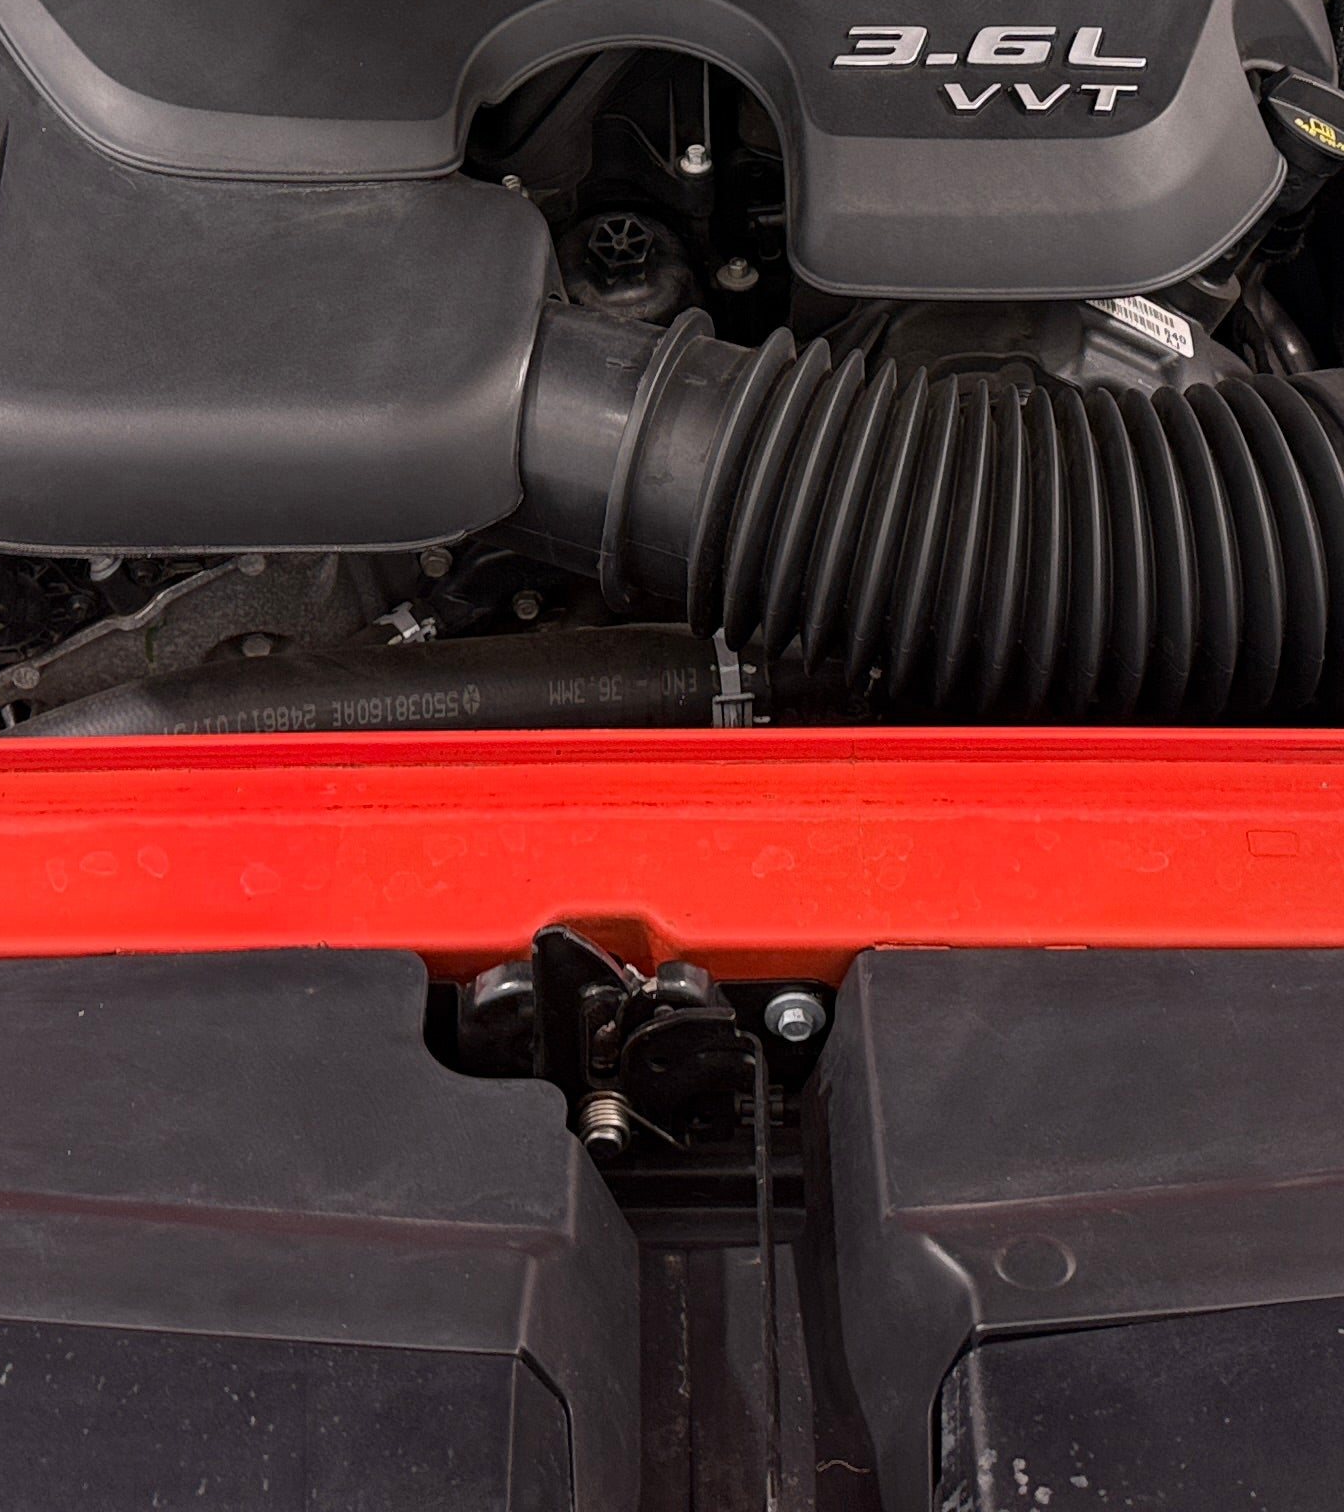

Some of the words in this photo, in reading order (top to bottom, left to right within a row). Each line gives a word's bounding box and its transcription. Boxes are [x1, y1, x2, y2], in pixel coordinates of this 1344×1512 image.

[831, 25, 1148, 69] 3.6L
[941, 82, 1139, 114] VVT
[548, 674, 624, 706] 36.3MM
[331, 690, 460, 727] 55038160AE
